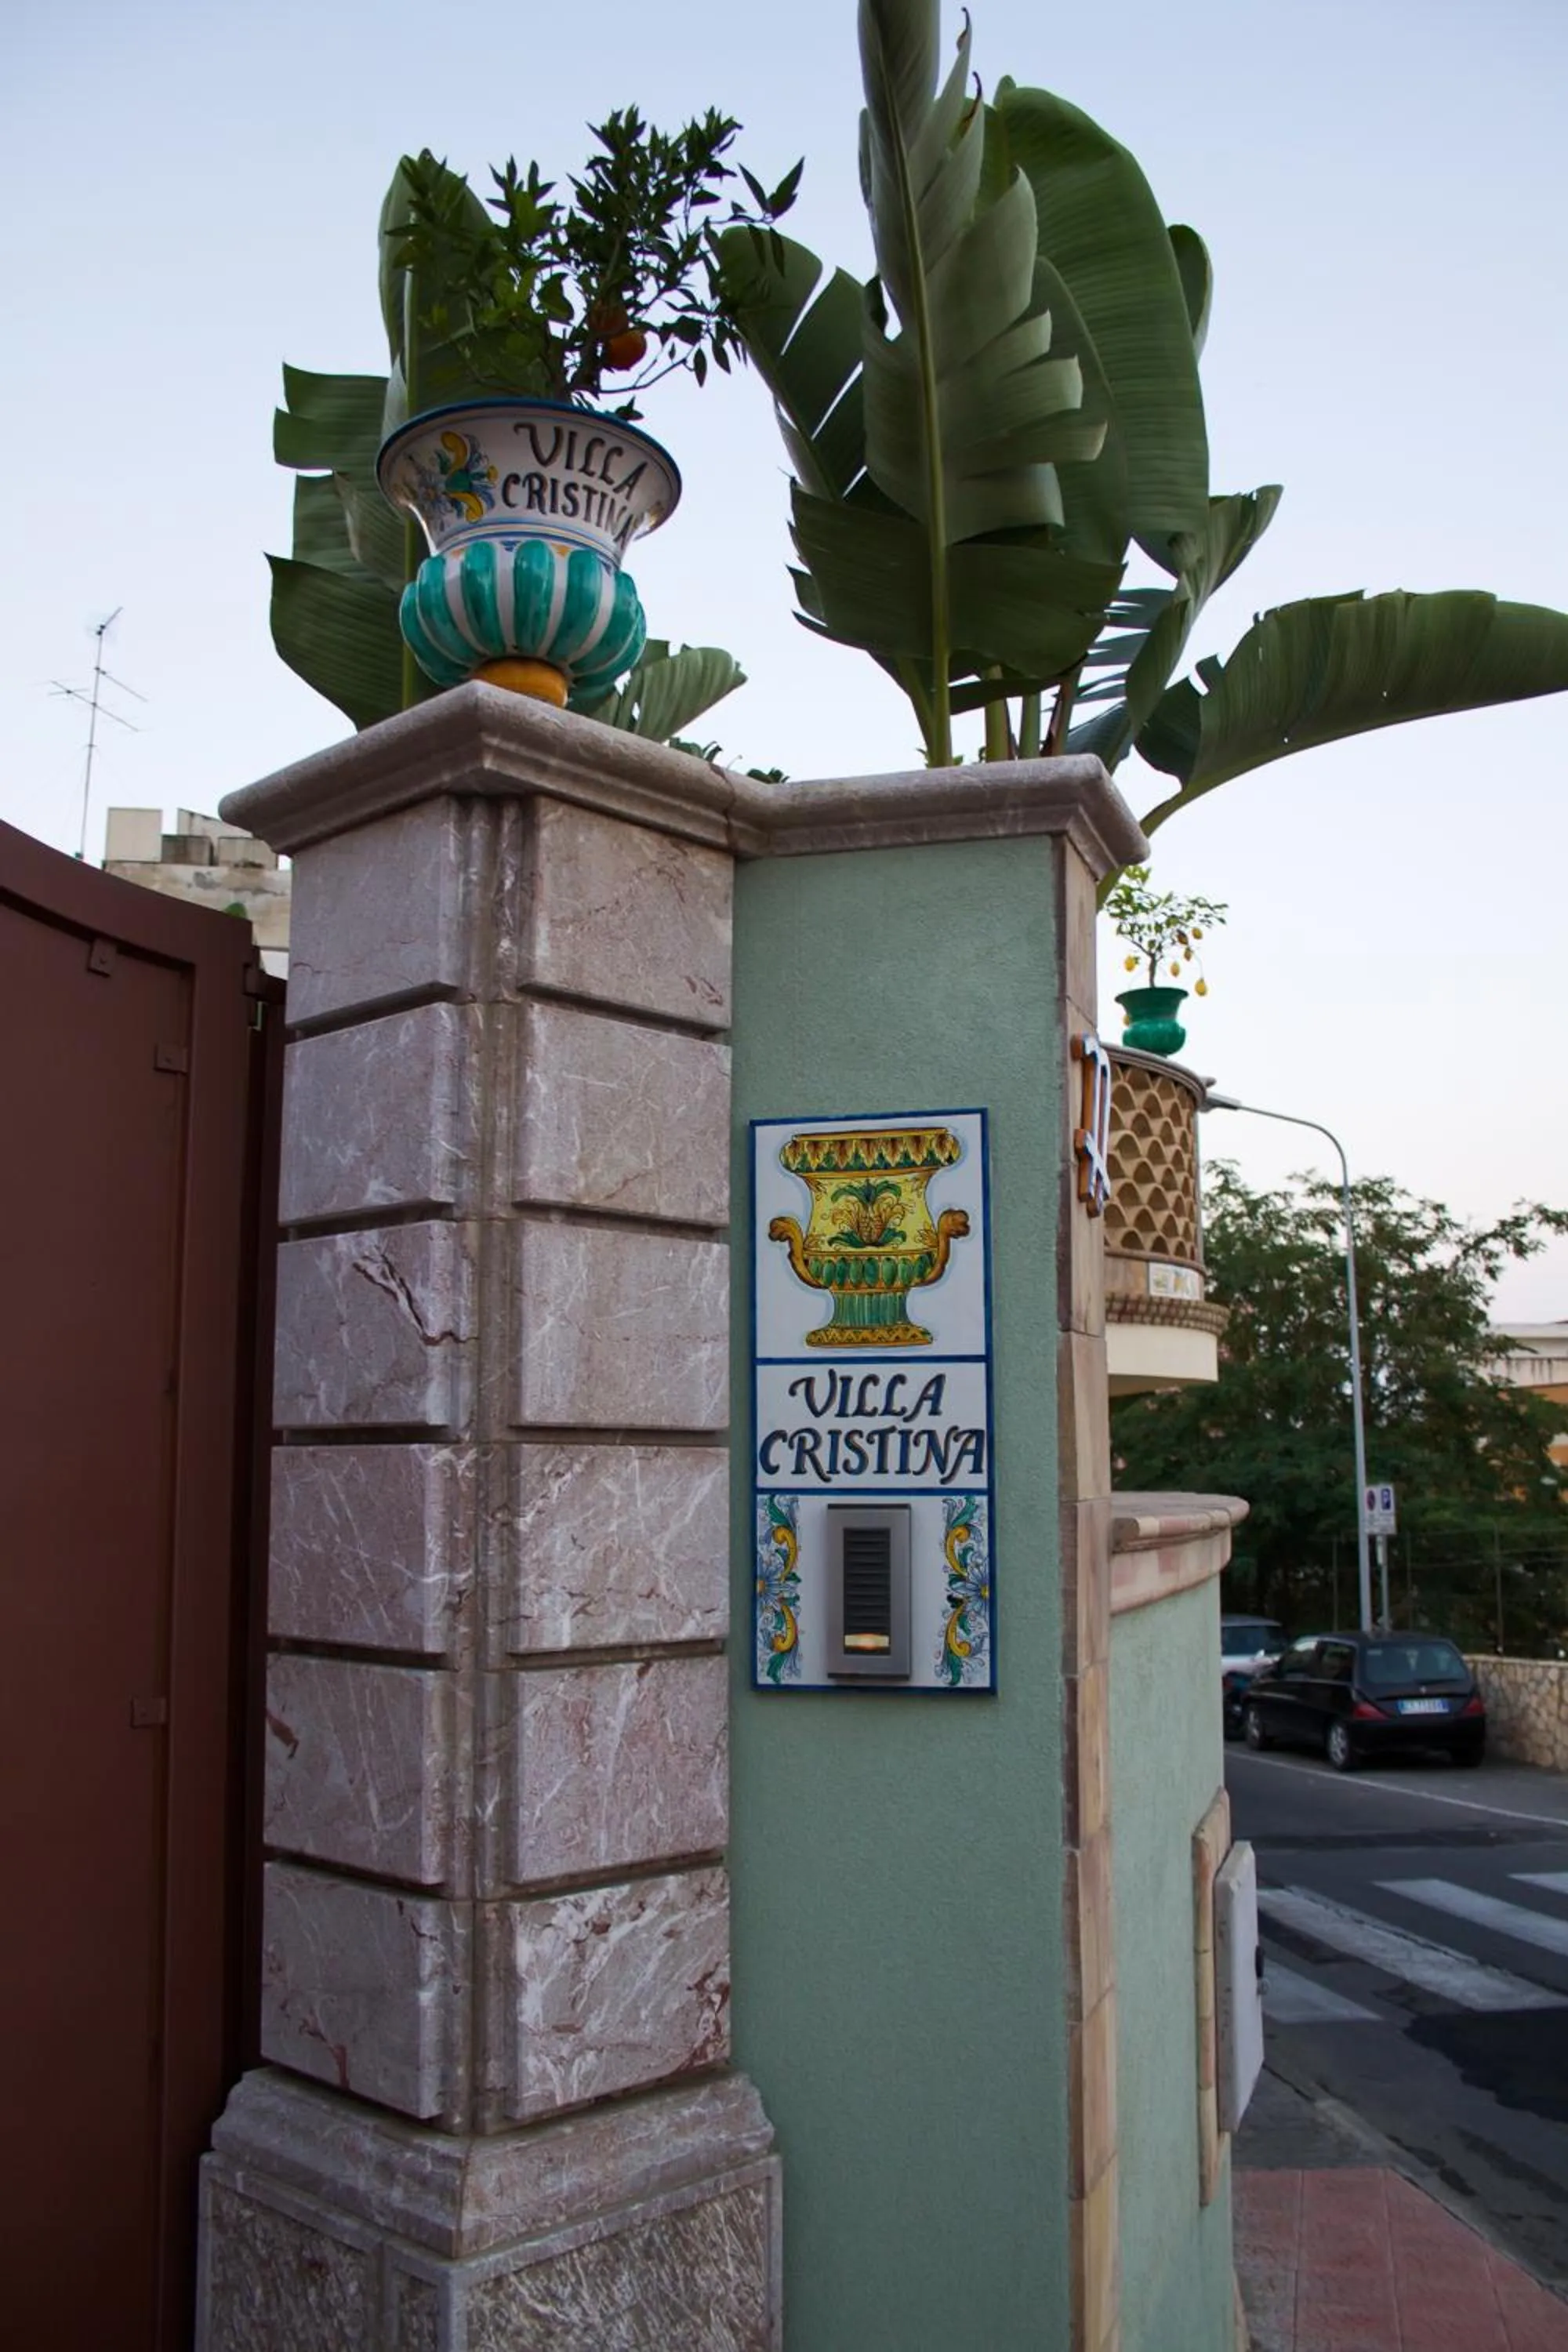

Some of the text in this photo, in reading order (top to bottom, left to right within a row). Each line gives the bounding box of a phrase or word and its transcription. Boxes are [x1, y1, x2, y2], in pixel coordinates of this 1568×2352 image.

[514, 422, 648, 499] VILLA
[501, 472, 634, 550] CRISTINA
[788, 1368, 946, 1423] VILLA
[759, 1425, 985, 1485] CRISTINA
